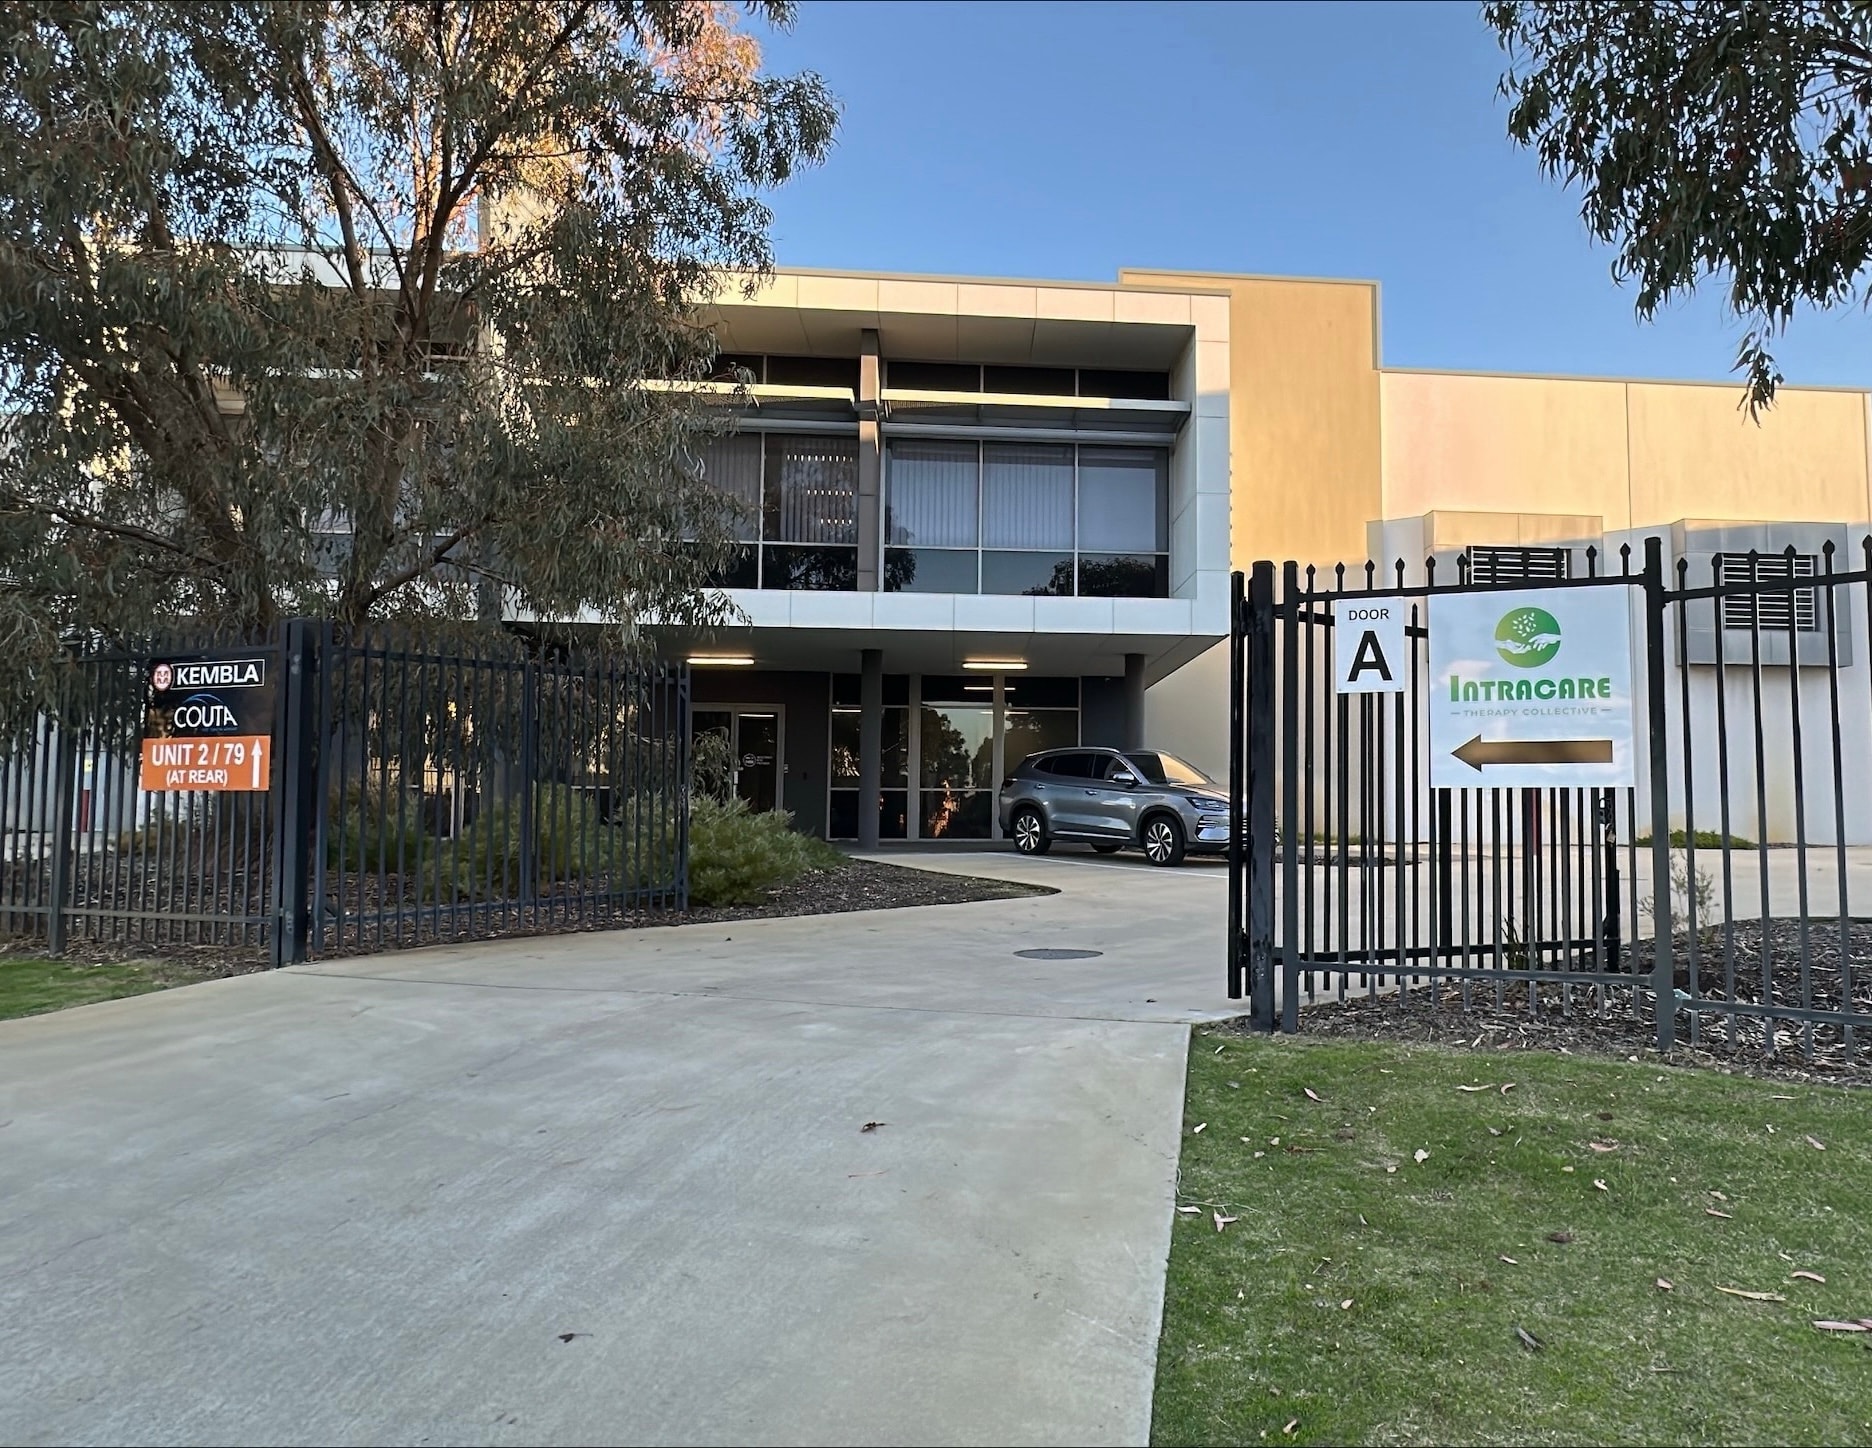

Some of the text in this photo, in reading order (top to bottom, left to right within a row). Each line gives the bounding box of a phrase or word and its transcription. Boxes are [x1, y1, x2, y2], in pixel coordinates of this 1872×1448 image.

[1348, 608, 1390, 621] DOOR
[1347, 630, 1393, 682] A
[177, 664, 259, 685] KEMBLA
[1450, 675, 1611, 702] INTRACARE
[174, 705, 238, 728] COUTA
[1464, 707, 1597, 717] THERAPY COLLECTIVE
[152, 743, 245, 766] UNIT 2 / 79
[166, 769, 228, 787] (AT REAR)
